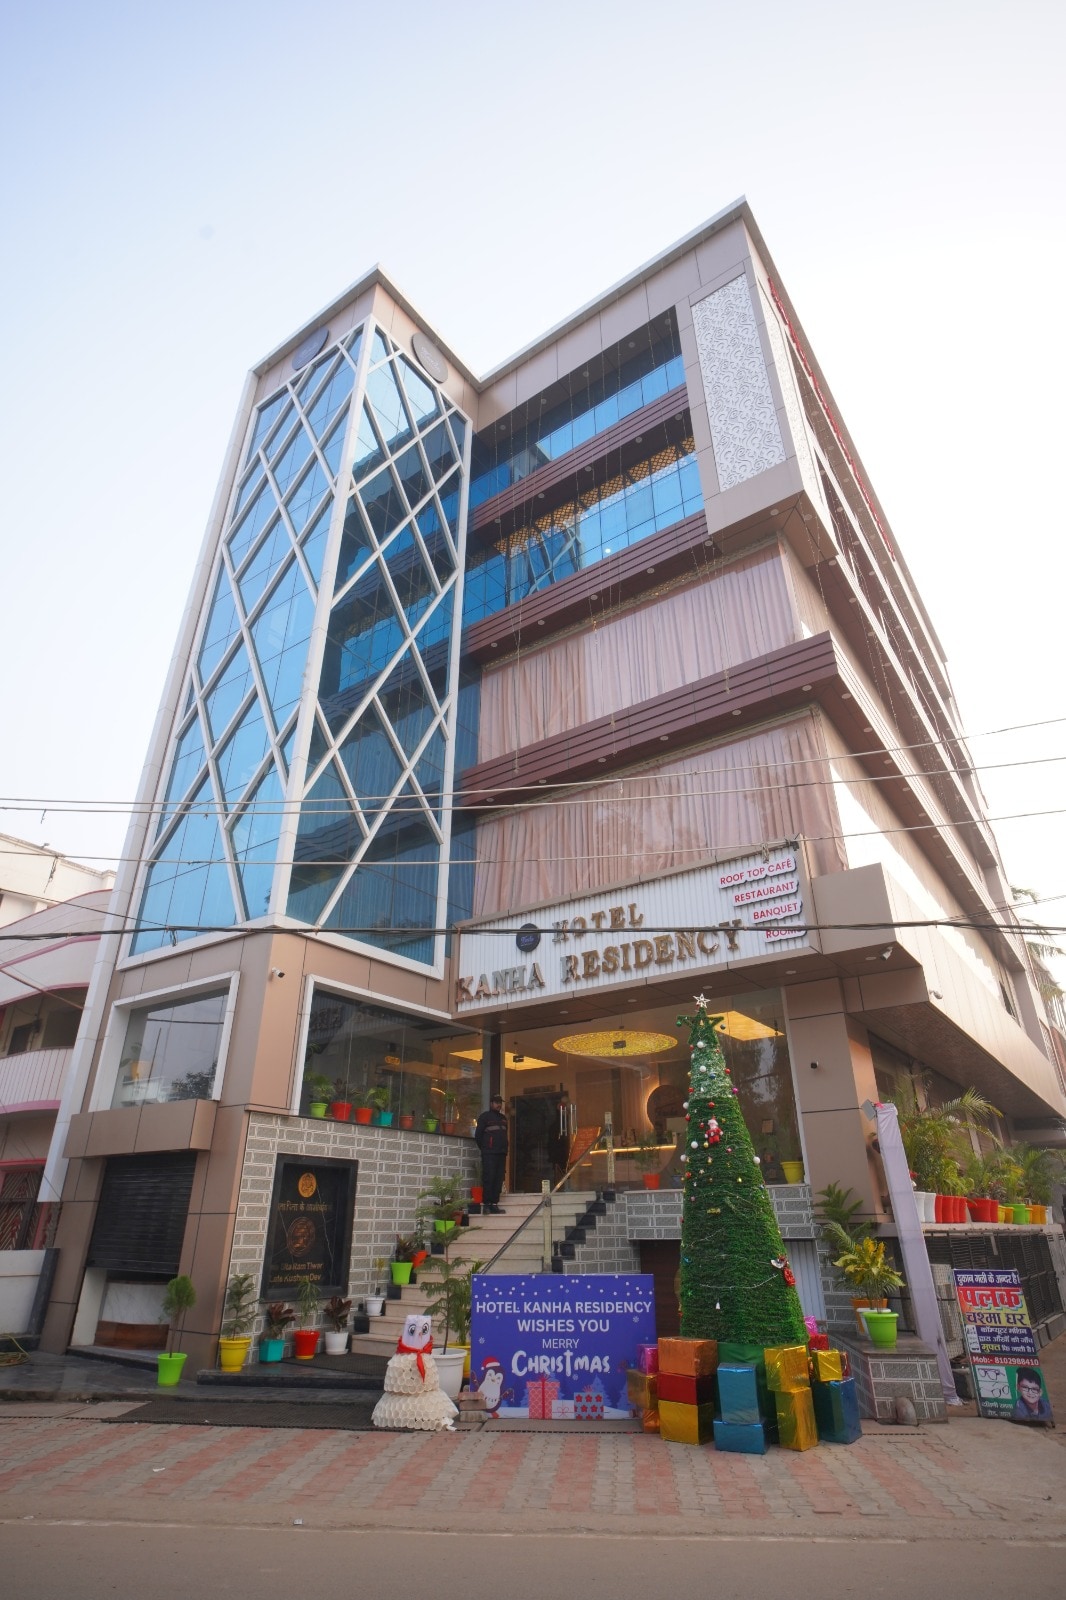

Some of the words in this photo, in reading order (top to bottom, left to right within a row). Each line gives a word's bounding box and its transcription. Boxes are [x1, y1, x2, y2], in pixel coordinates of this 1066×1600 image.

[720, 871, 744, 885] ROOF
[746, 866, 765, 878] TOP
[734, 881, 795, 903] RESTAURANT
[753, 902, 798, 920] BANQUET
[551, 902, 644, 944] HOTEL
[457, 962, 545, 1003] KANHA
[559, 918, 742, 984] RESIDENCY
[957, 1274, 974, 1287] दुकान
[974, 1271, 988, 1284] गली
[987, 1271, 994, 1284] के
[476, 1301, 520, 1314] HOTEL
[523, 1301, 572, 1314] KANHA
[575, 1301, 652, 1314] RESIDENCY
[960, 1286, 1023, 1311] पलक
[517, 1319, 575, 1333] WISHES
[578, 1319, 610, 1332] YOU
[966, 1312, 1002, 1325] चश्मा
[1004, 1313, 1027, 1326] घर
[542, 1338, 580, 1349] MERRY
